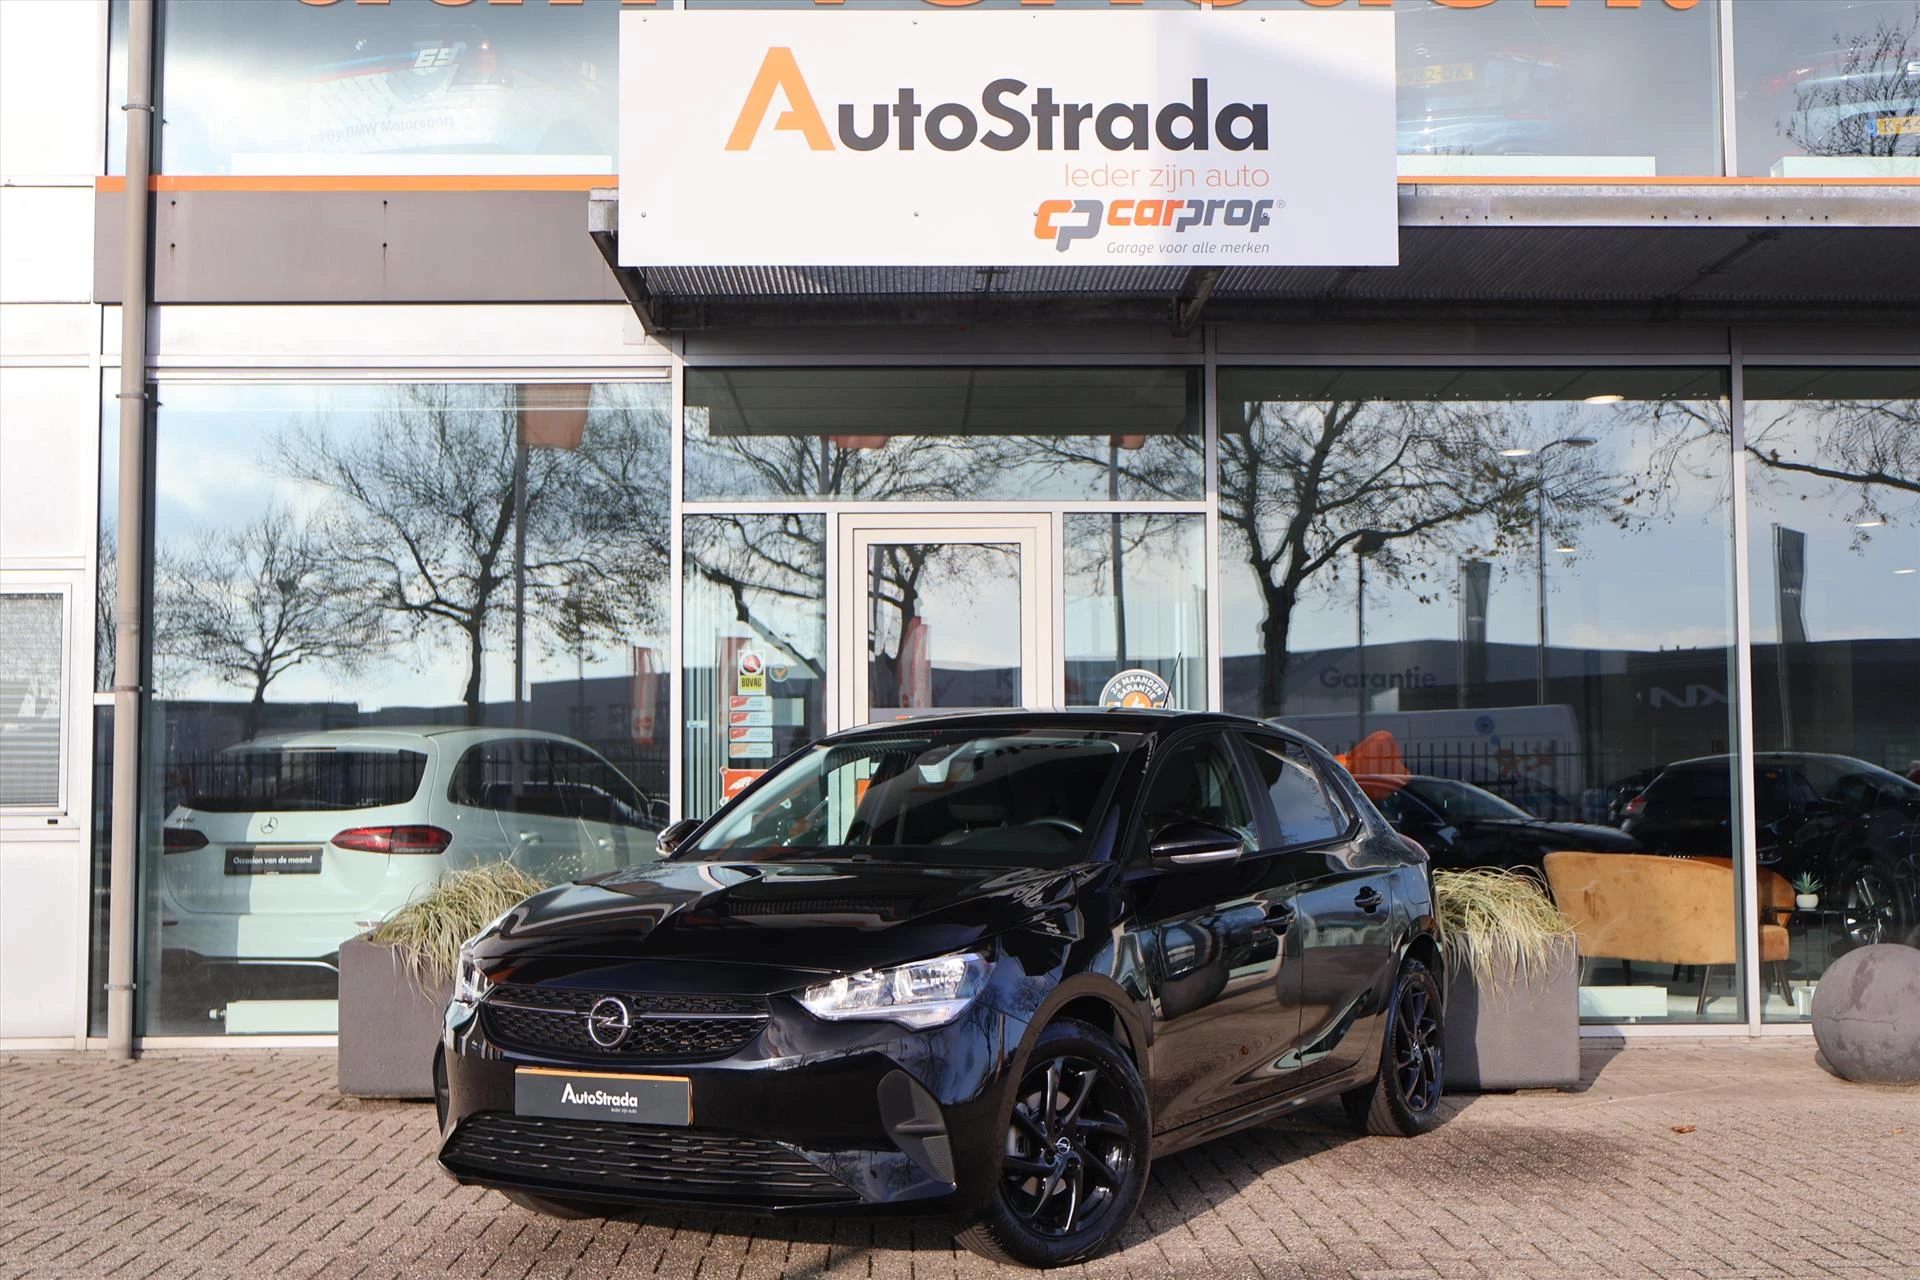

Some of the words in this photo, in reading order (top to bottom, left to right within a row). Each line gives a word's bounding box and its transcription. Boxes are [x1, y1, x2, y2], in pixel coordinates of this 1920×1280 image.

[724, 46, 1270, 152] AutoStrada
[346, 122, 378, 139] BMW
[381, 115, 455, 134] Motorsport
[1065, 163, 1140, 188] Ieder
[1149, 163, 1196, 193] zijn
[1206, 166, 1270, 188] auto
[1106, 241, 1154, 257] Garage
[1159, 244, 1189, 254] voor
[1192, 241, 1216, 254] alle
[1220, 241, 1270, 254] merken
[741, 677, 762, 688] BOVAG
[1110, 682, 1122, 695] 24
[1121, 675, 1164, 696] MAANDEN
[1319, 665, 1437, 689] Garantie
[1116, 683, 1157, 700] GARANTIE
[233, 855, 263, 865] Occasion
[278, 855, 287, 864] de
[288, 855, 313, 864] maand
[560, 1082, 638, 1107] AutoStrada
